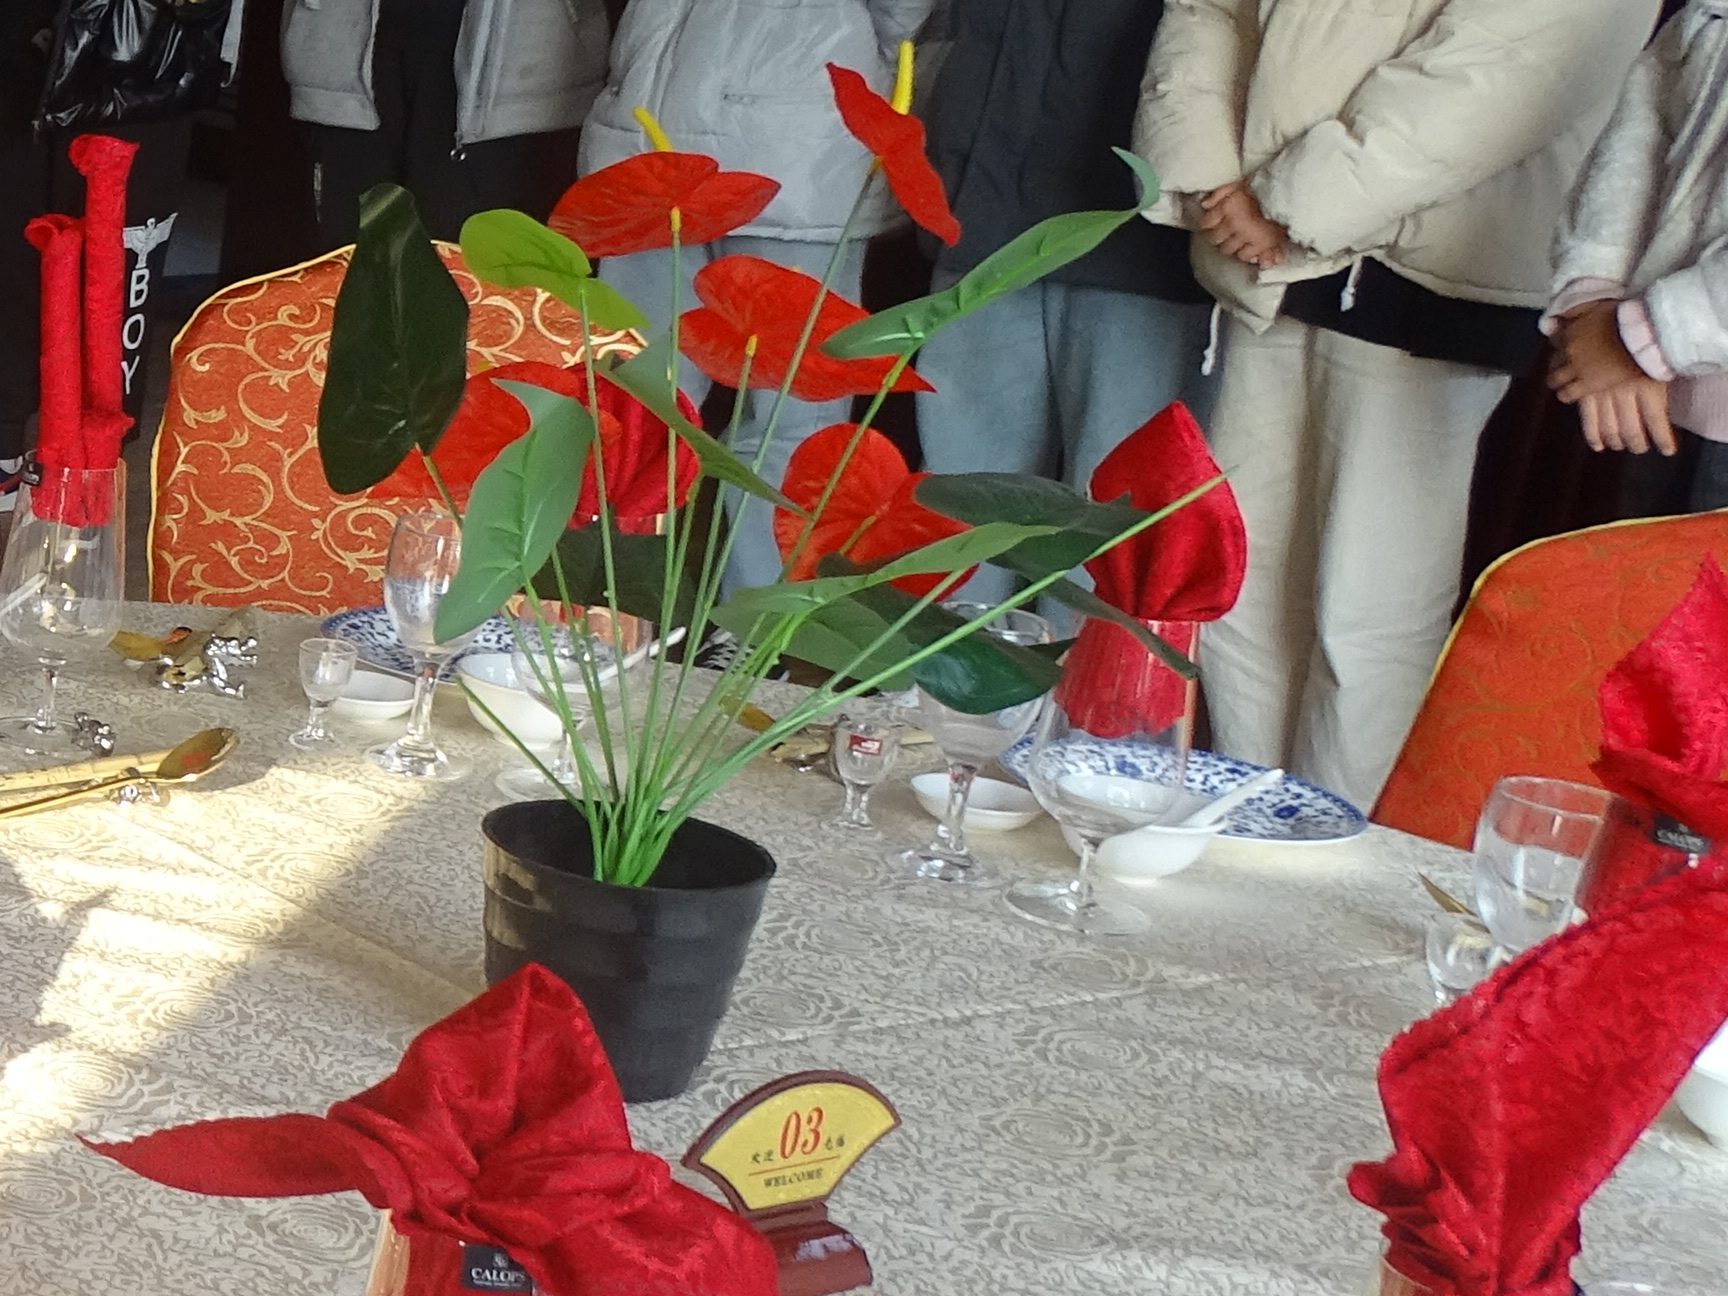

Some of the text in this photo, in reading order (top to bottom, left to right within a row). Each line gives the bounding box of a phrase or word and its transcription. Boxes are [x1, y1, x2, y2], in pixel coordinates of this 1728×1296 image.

[121, 268, 150, 395] BOY
[779, 1106, 824, 1159] 03
[762, 1168, 825, 1189] WELCOME
